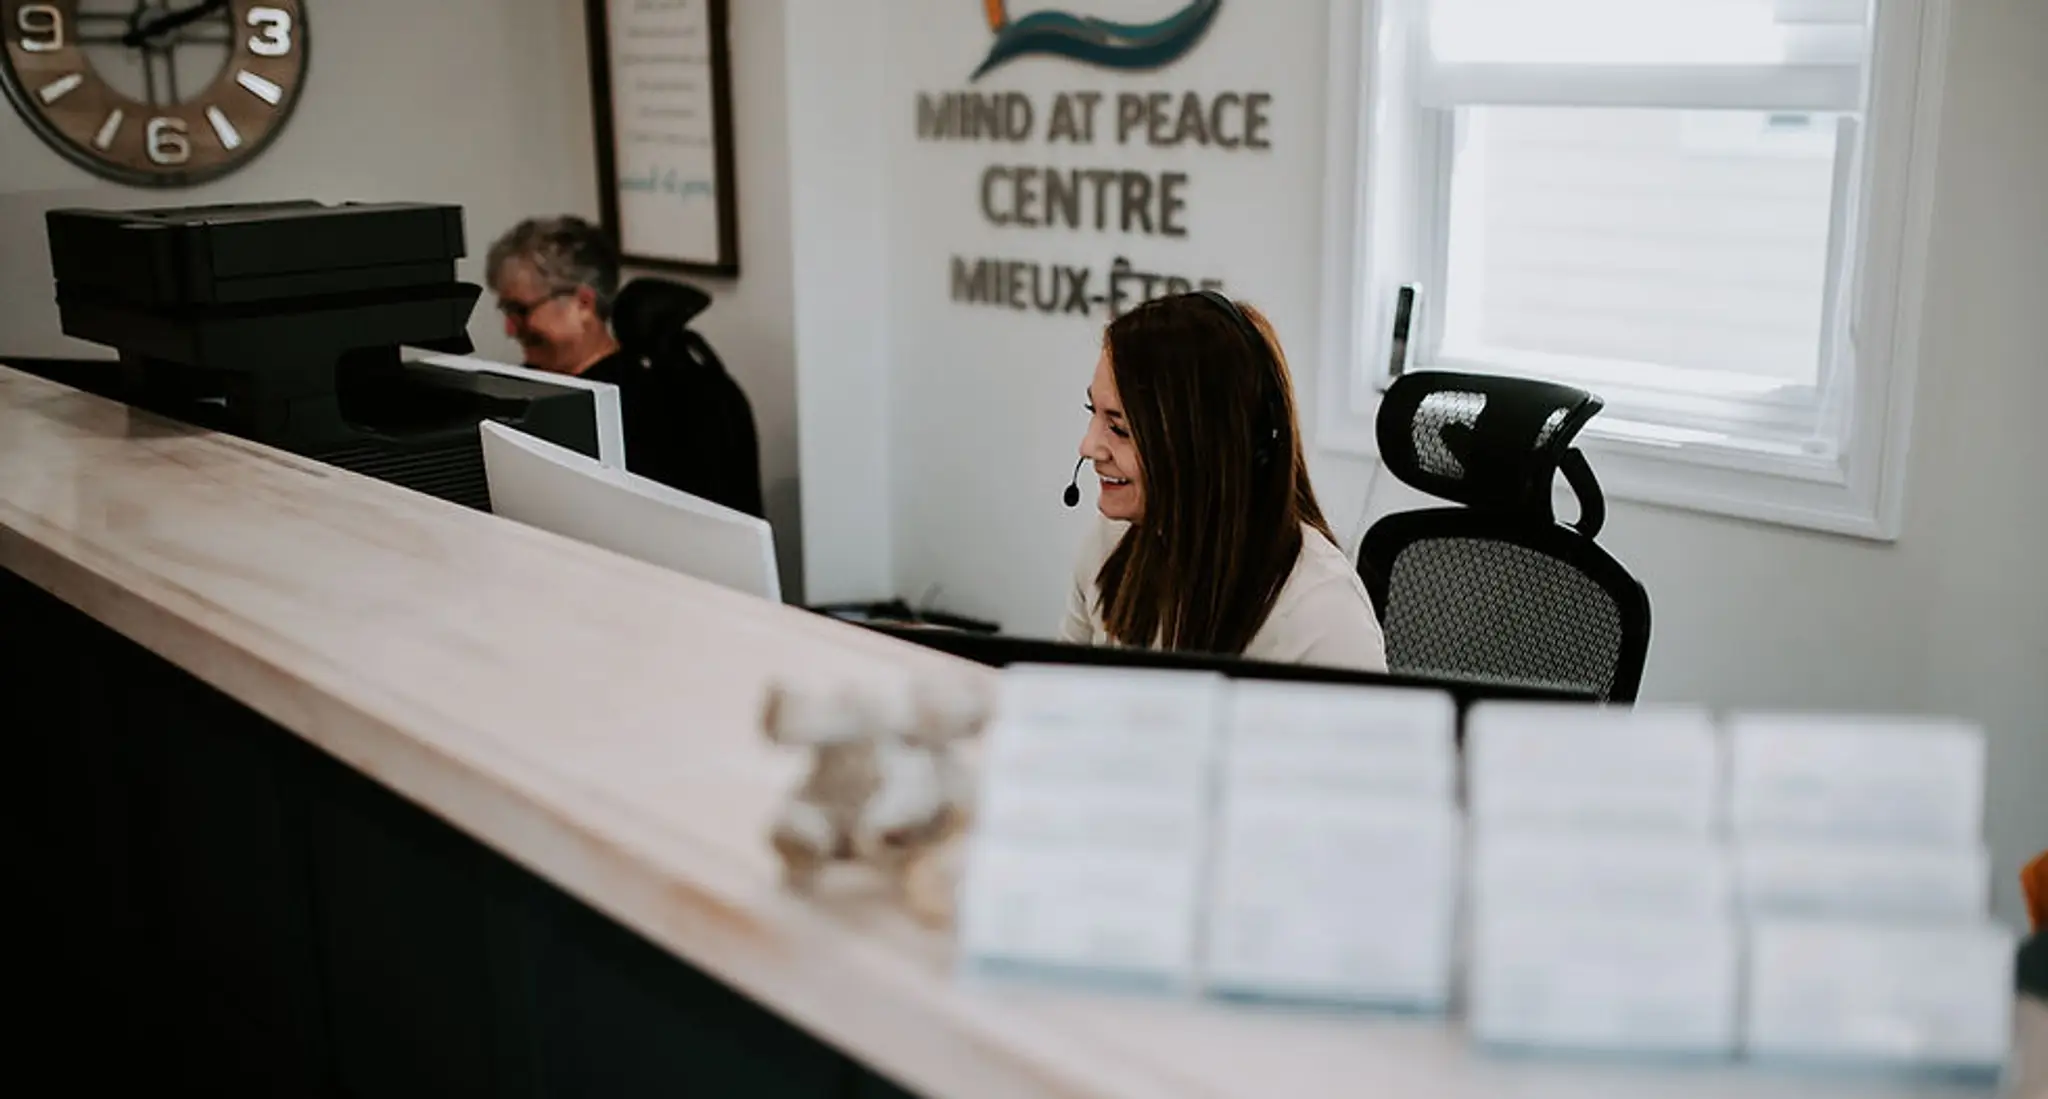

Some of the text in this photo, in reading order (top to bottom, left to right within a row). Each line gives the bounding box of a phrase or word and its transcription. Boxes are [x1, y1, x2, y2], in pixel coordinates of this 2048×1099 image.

[18, 5, 63, 51] 9
[247, 7, 292, 56] 3
[147, 117, 191, 165] 6
[915, 91, 1273, 149] MIND AT PEACE
[981, 165, 1188, 238] CENTRE
[950, 254, 1222, 317] MIEUX-ÊT
